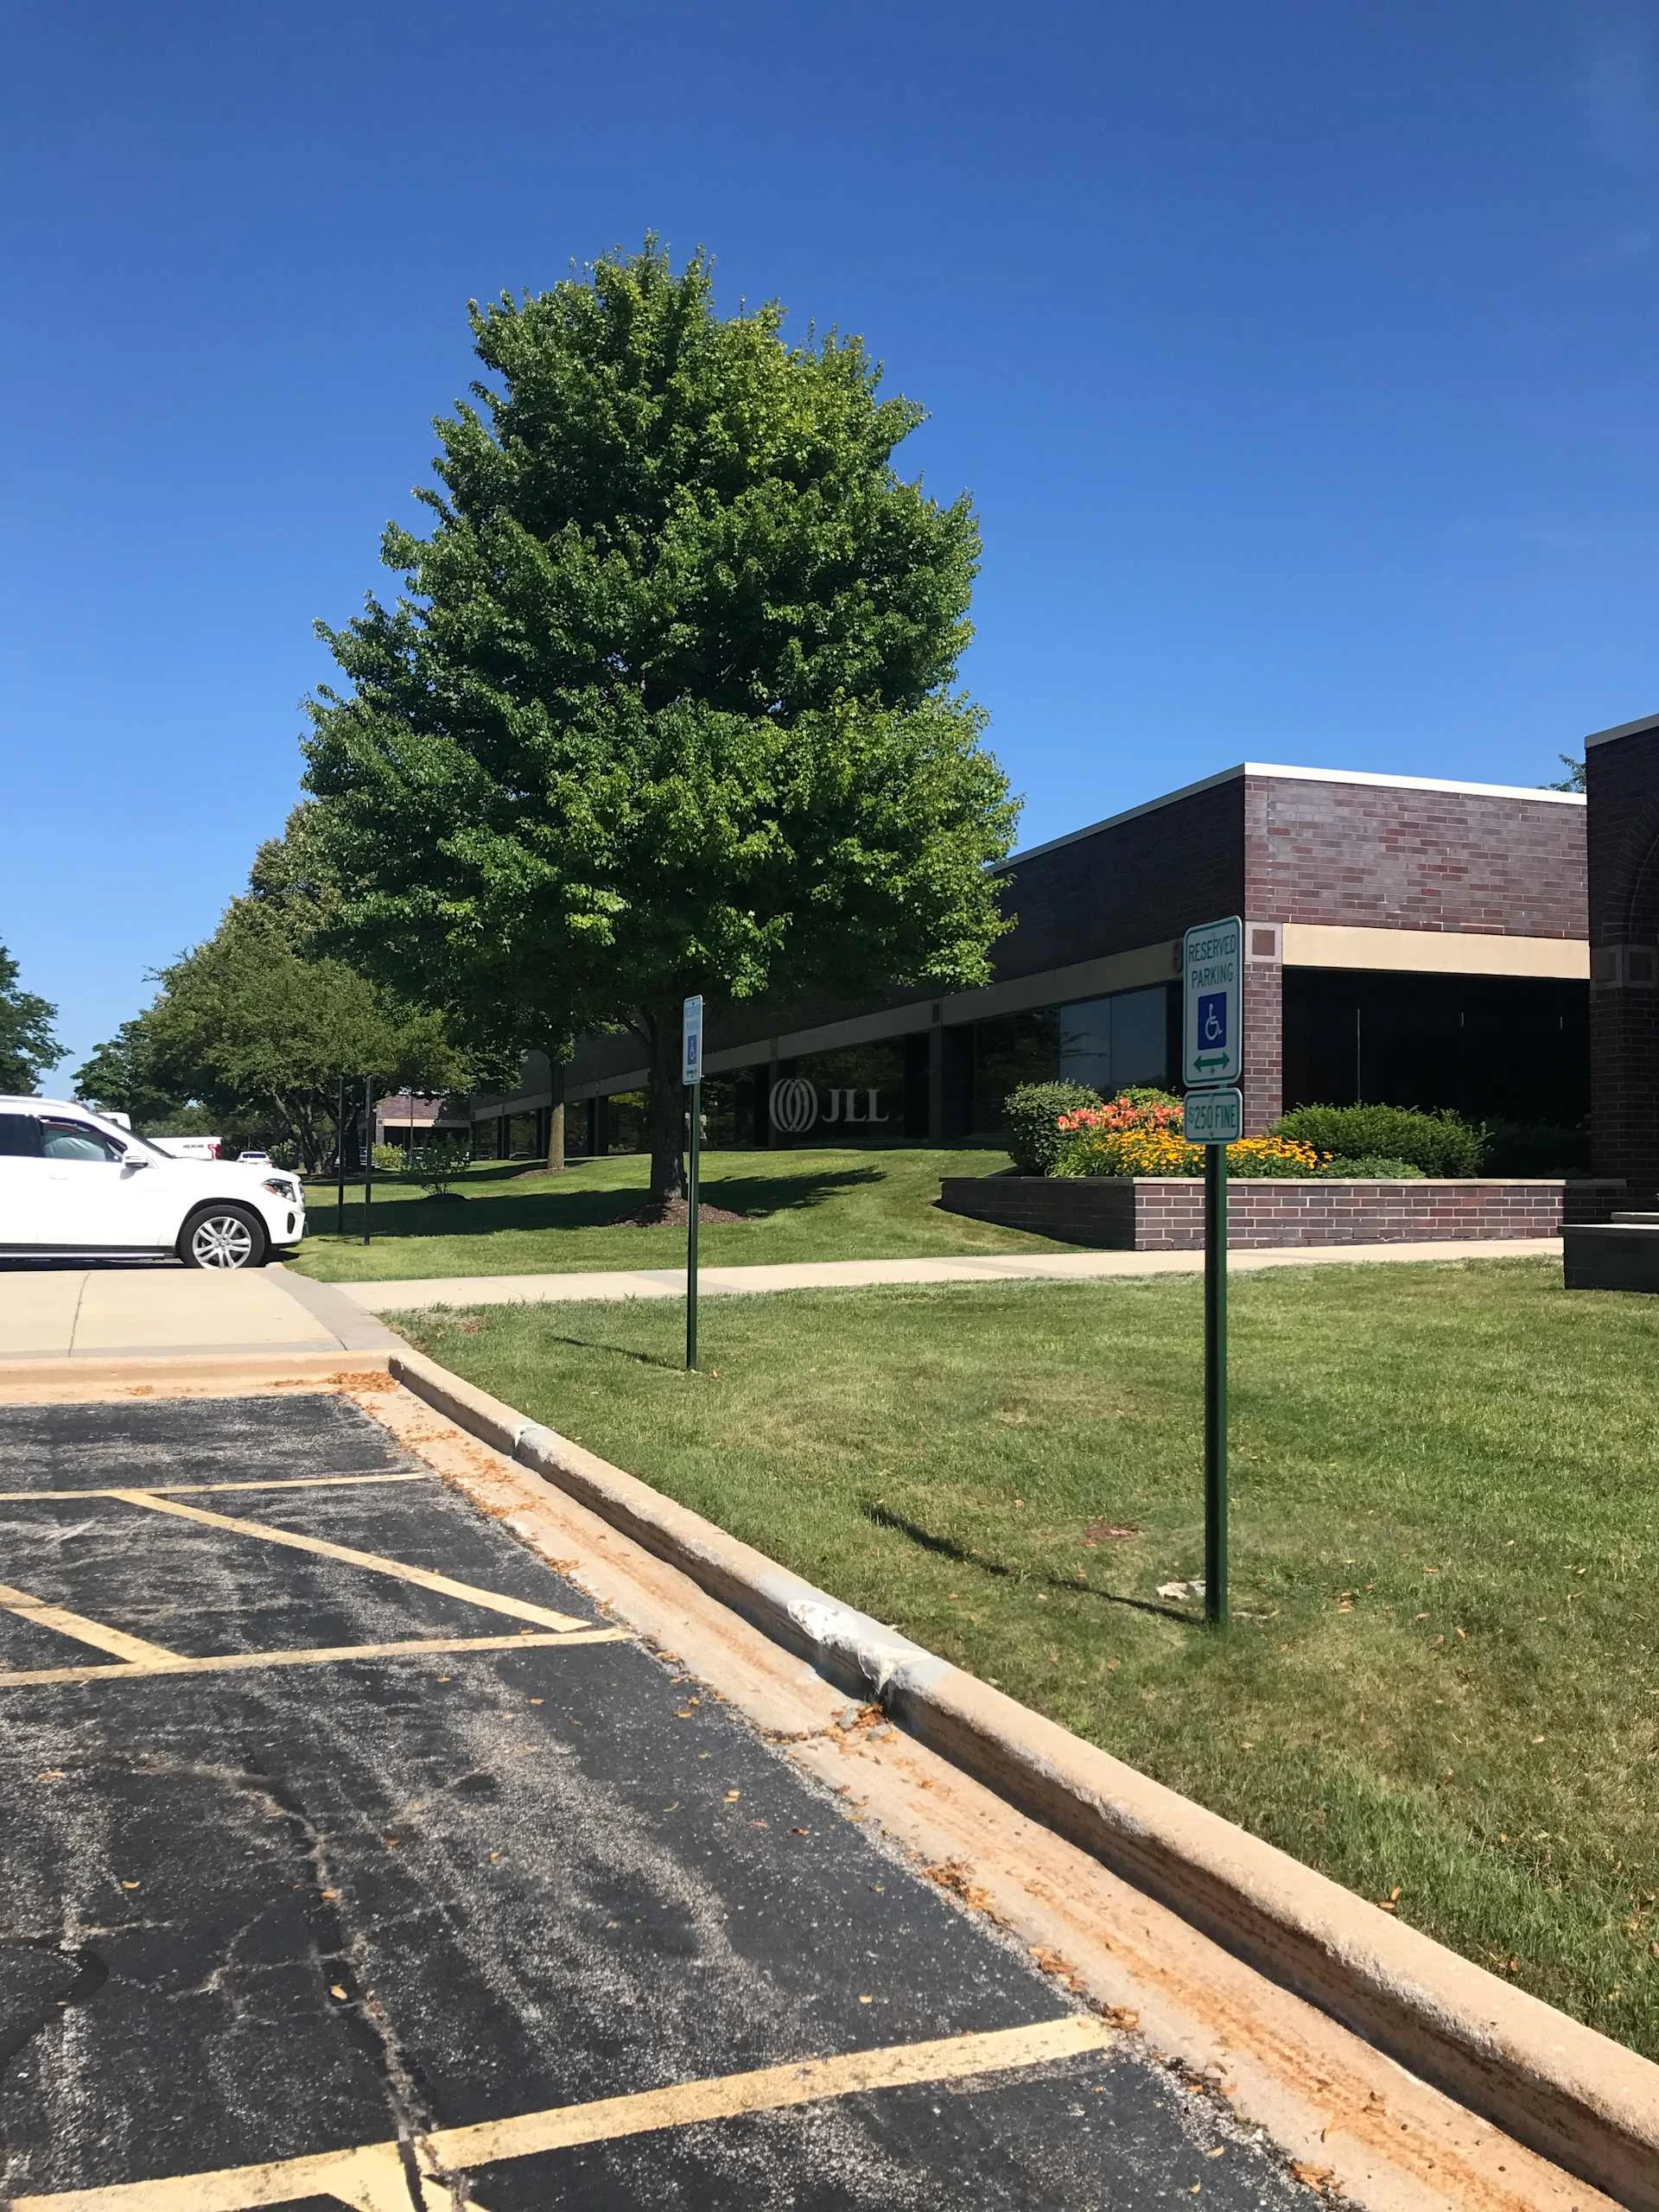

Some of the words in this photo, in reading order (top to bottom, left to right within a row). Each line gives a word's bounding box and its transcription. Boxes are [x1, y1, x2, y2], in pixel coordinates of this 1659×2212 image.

[1188, 934, 1236, 963] RESERVED
[1192, 963, 1234, 989] PARKING
[822, 1089, 890, 1122] JLL
[1187, 1105, 1213, 1129] $250
[1215, 1103, 1236, 1129] FINE
